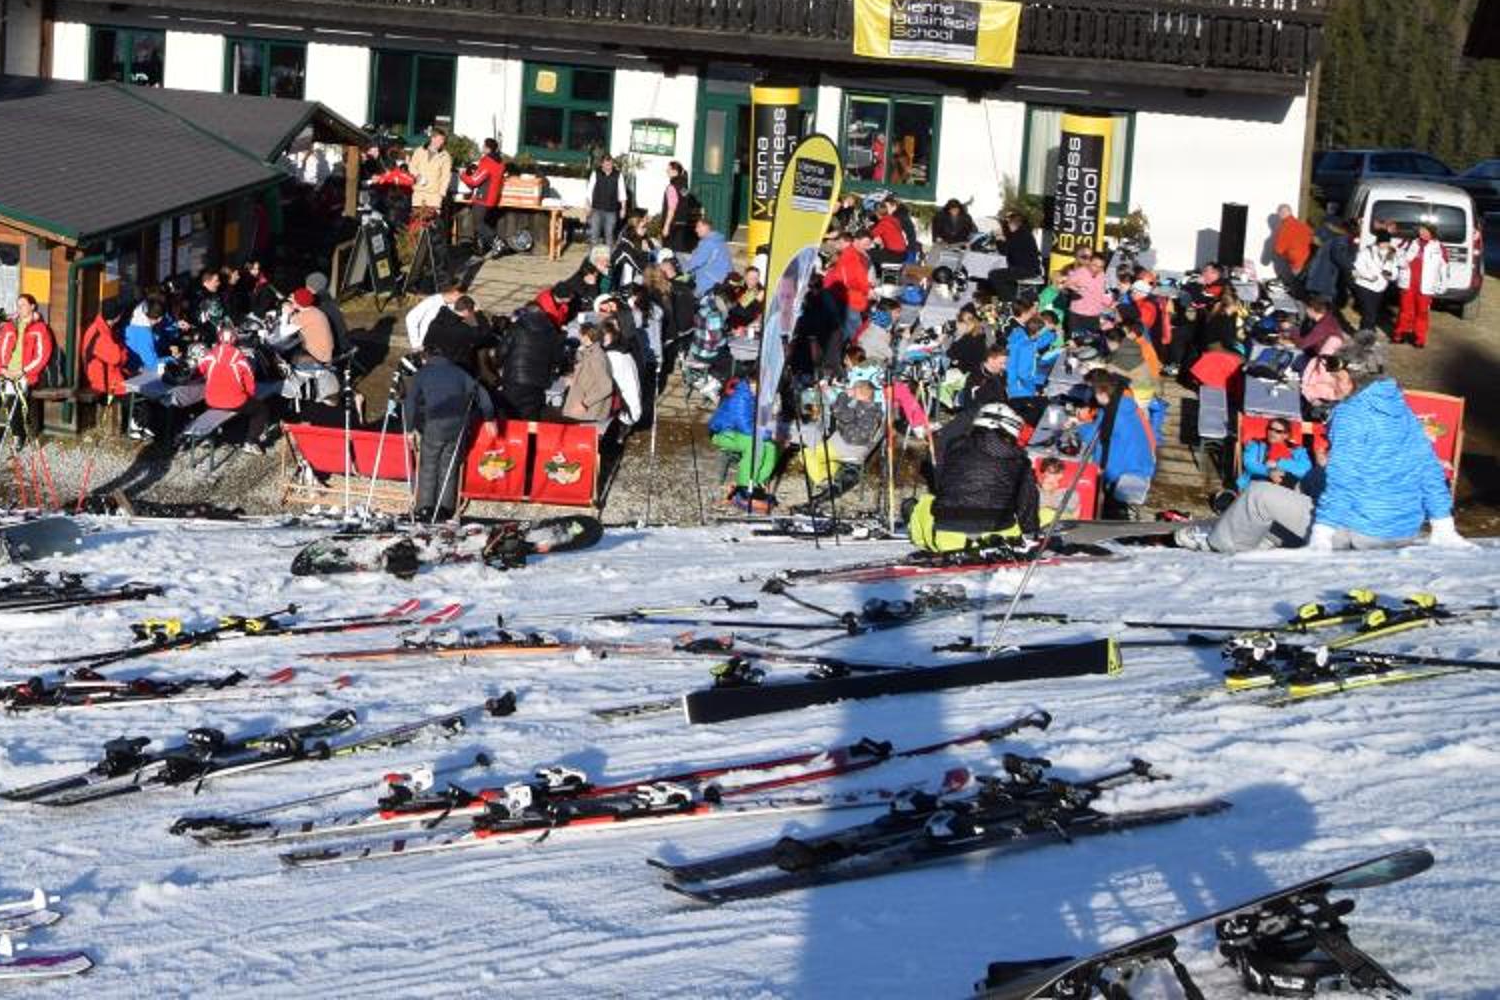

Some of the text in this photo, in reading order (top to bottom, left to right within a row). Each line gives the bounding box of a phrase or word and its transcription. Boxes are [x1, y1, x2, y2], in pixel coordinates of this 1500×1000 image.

[892, 25, 954, 41] School
[893, 13, 977, 31] Business
[753, 137, 769, 216] Vienna
[1059, 137, 1081, 251] Business
